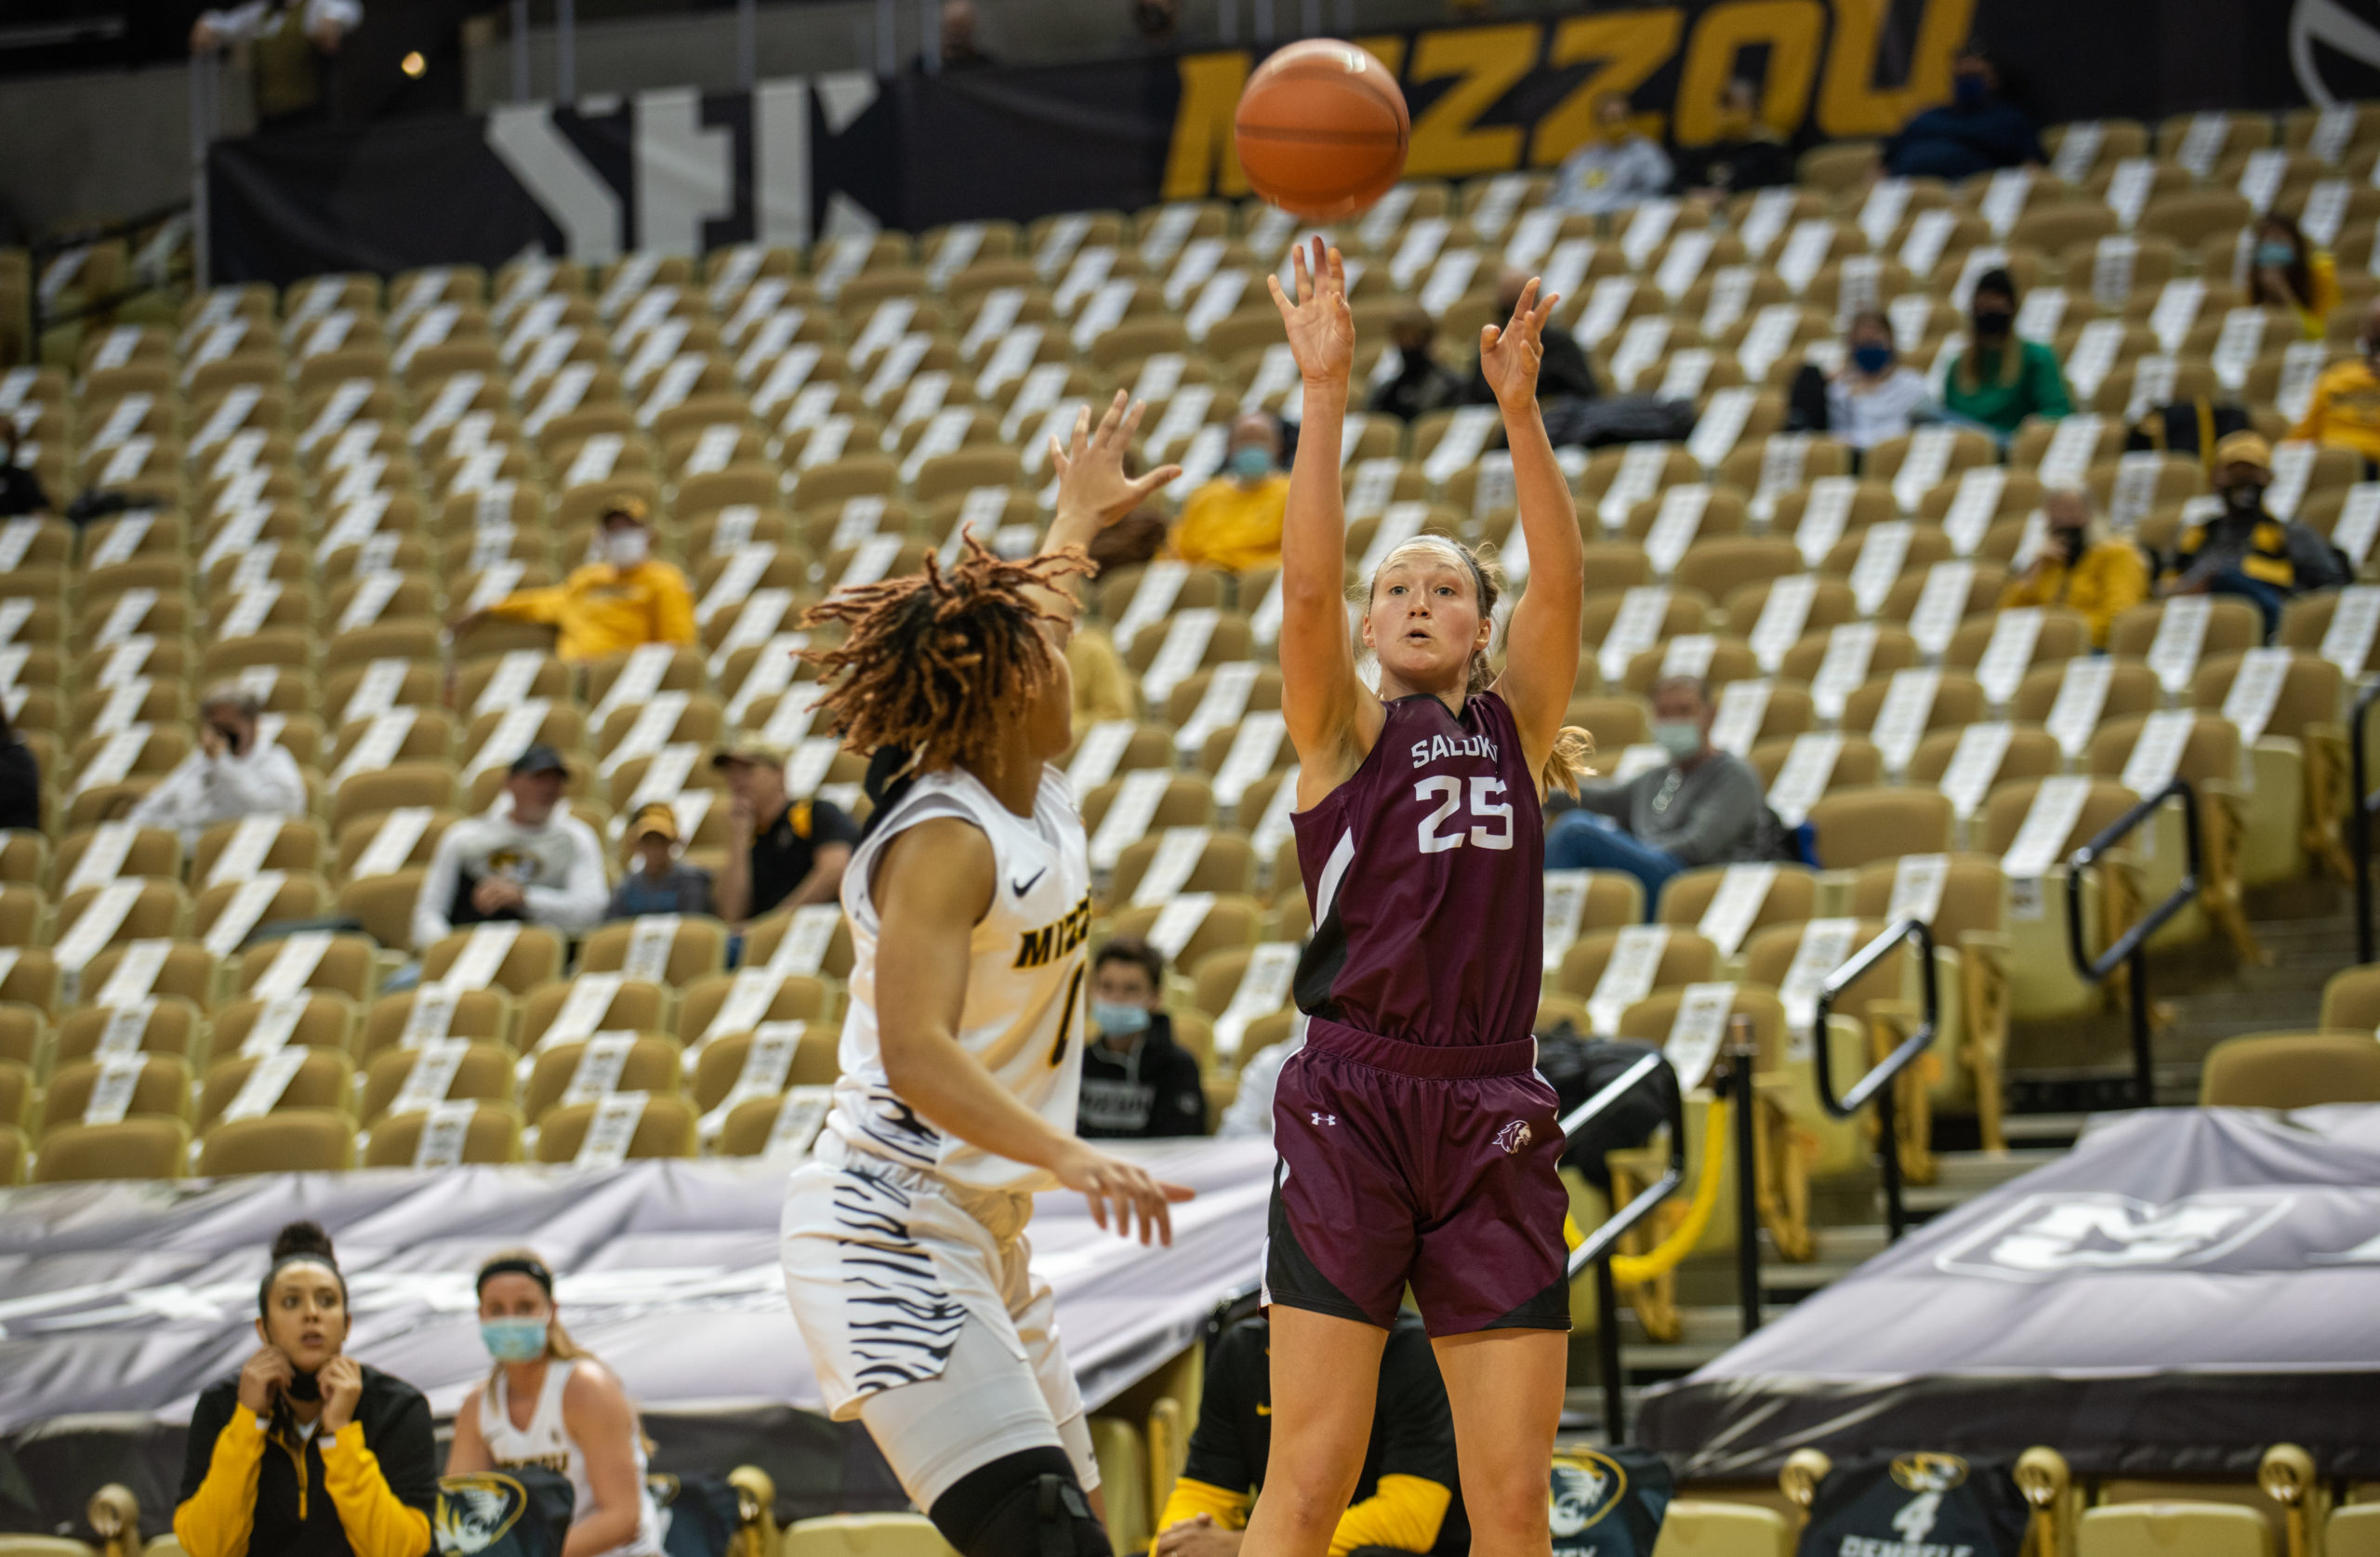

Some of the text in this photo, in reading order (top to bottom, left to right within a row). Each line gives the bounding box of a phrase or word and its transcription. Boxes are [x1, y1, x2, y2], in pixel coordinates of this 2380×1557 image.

[1161, 0, 1978, 201] MZZOU
[1413, 774, 1514, 854] 25
[1891, 1491, 1942, 1543] 4
